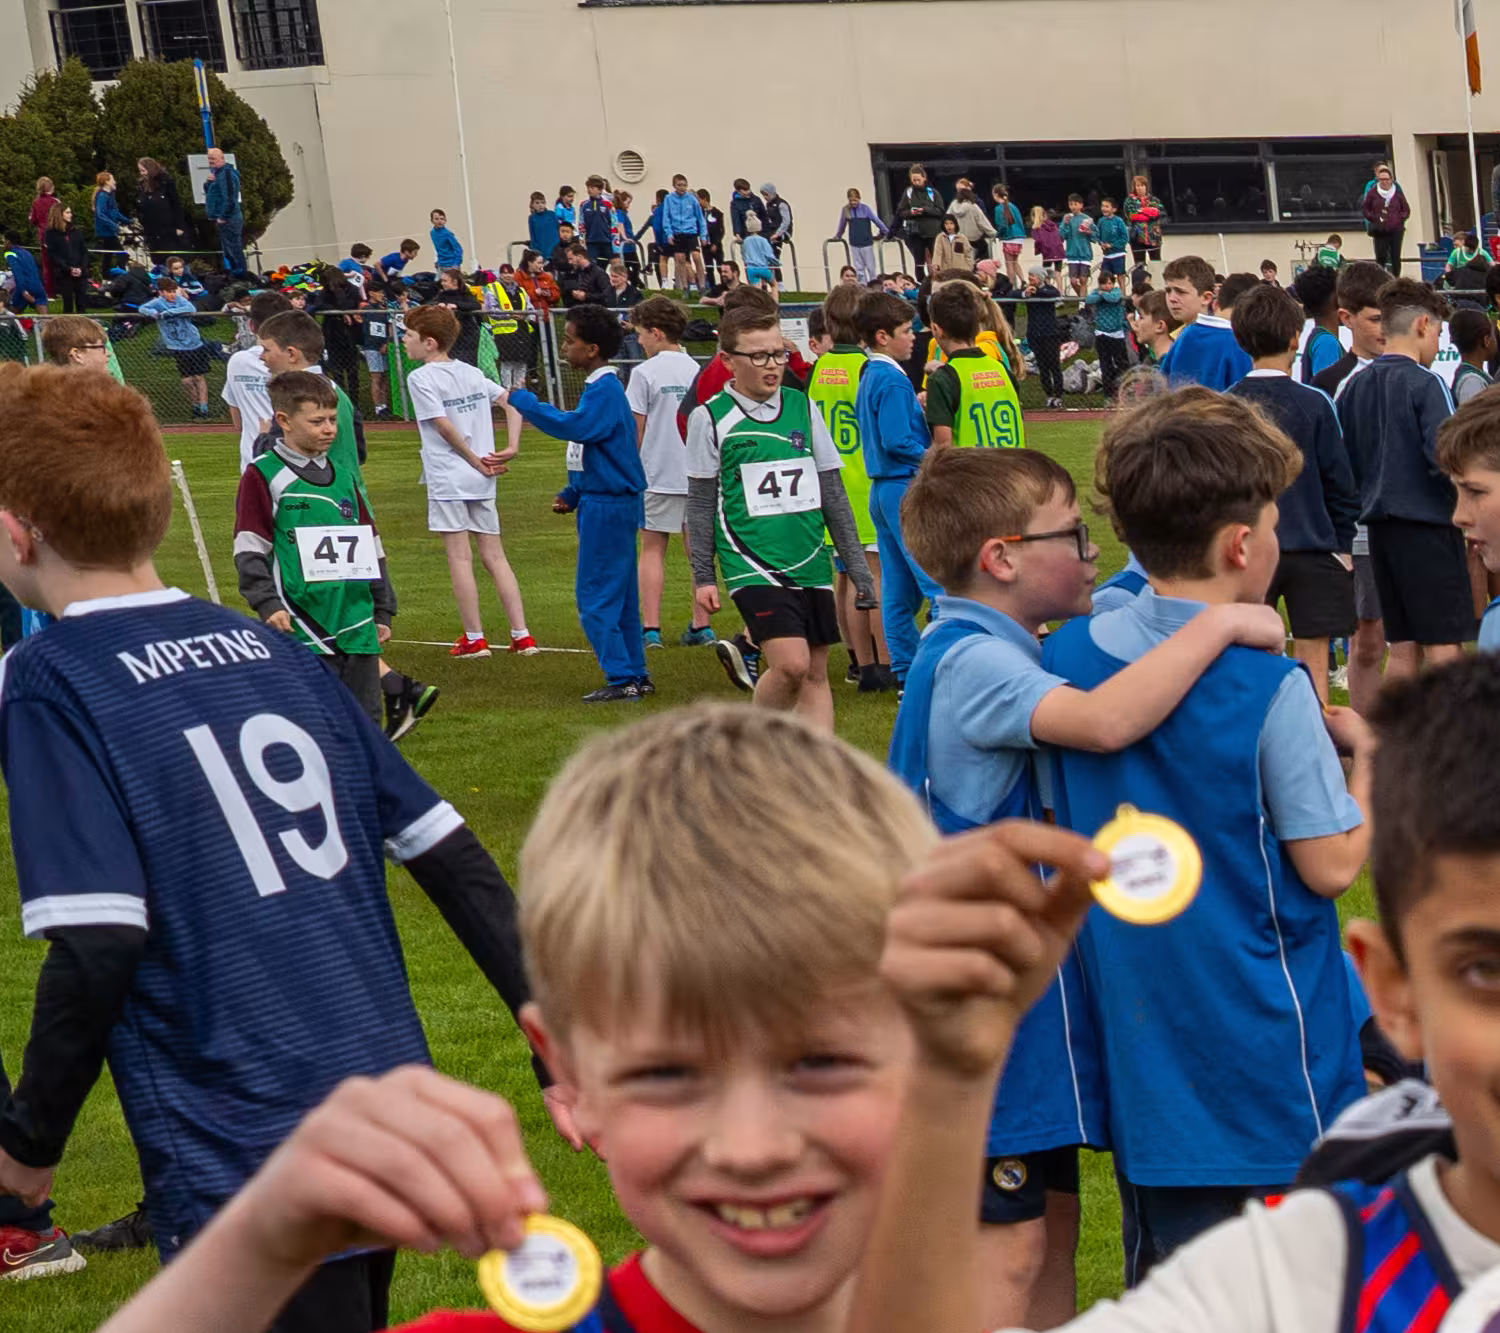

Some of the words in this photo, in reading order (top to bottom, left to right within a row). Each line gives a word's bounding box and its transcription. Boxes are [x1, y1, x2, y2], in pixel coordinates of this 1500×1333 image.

[969, 400, 1020, 449] 19
[757, 468, 804, 499] 47
[313, 535, 360, 564] 47
[117, 628, 272, 685] MPETNS
[182, 712, 350, 897] 19
